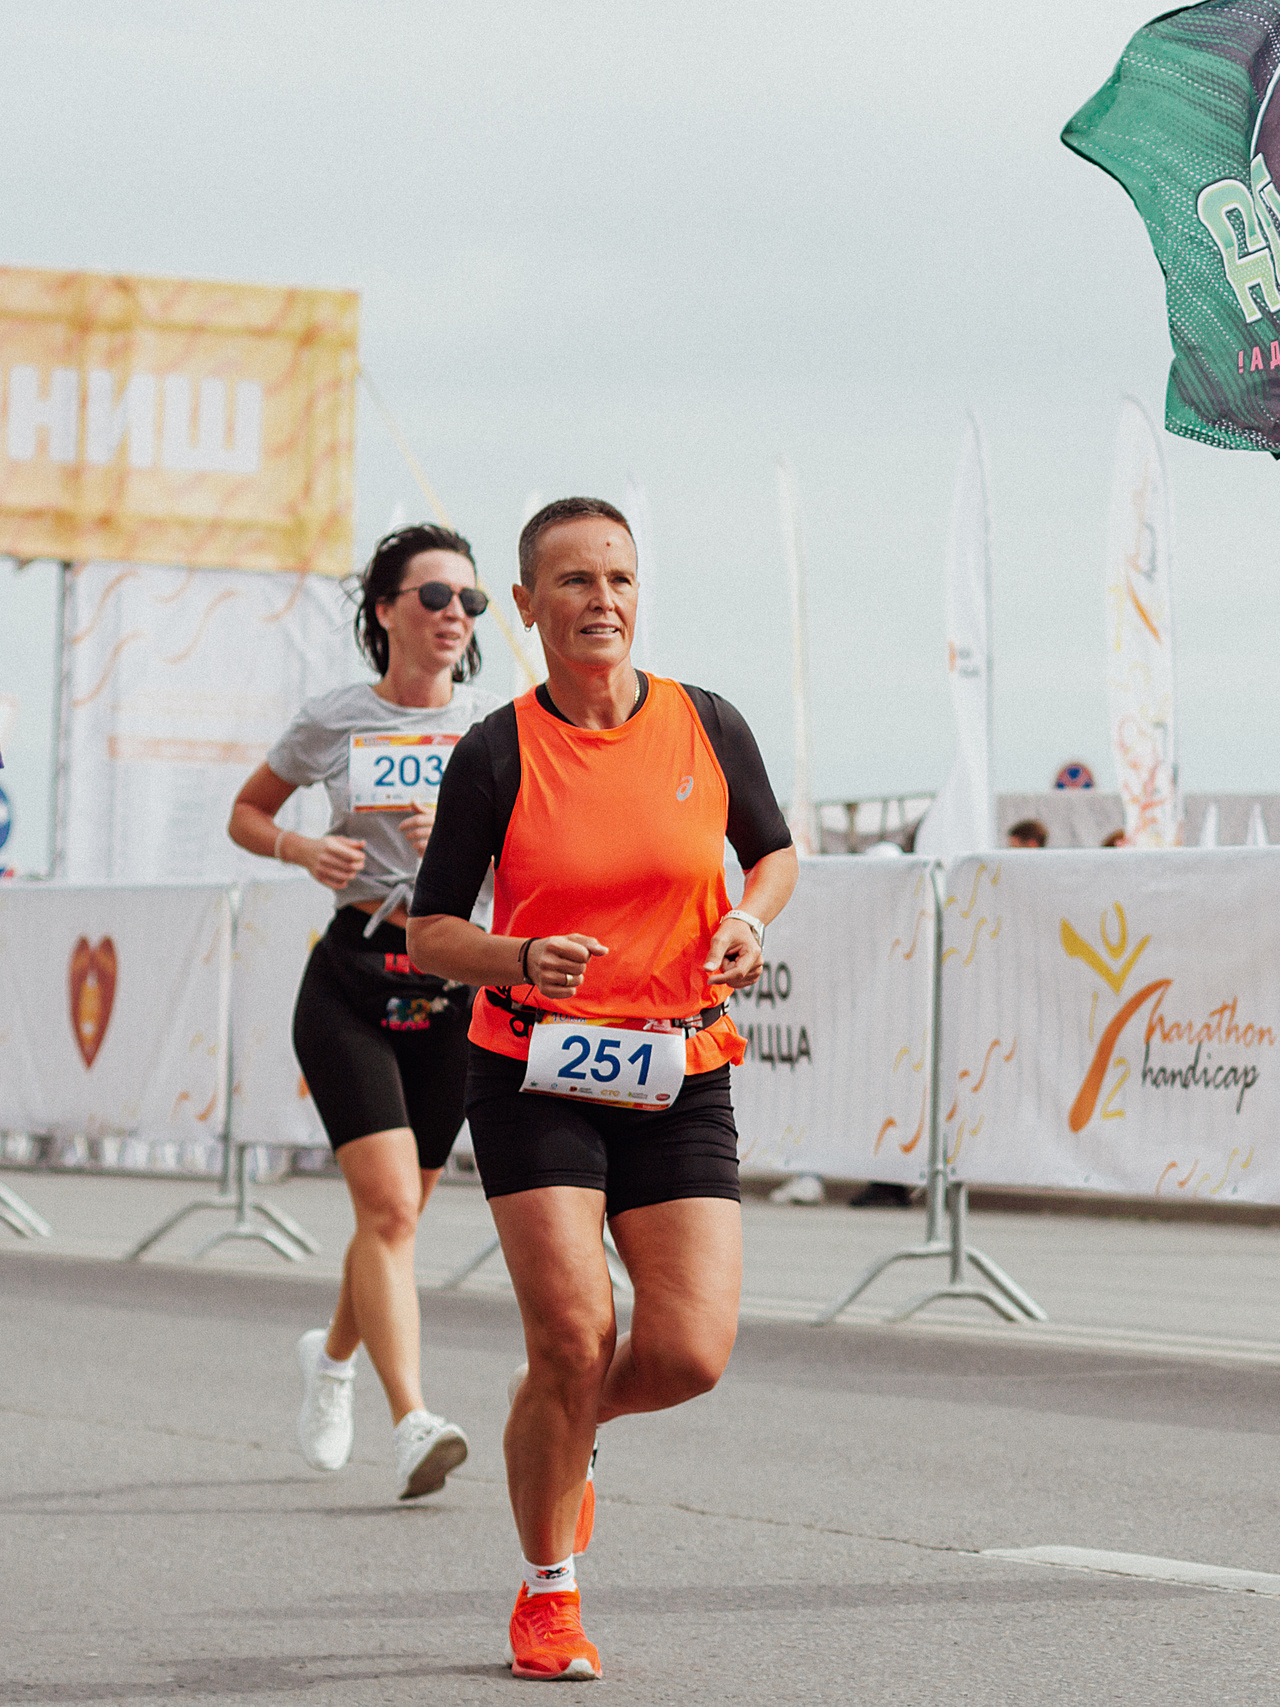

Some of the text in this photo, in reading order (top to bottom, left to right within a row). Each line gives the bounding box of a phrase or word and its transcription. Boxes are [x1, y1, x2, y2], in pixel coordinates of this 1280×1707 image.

[6, 363, 263, 475] НИШ
[374, 754, 443, 787] 203
[731, 961, 792, 1009] ДО
[557, 1034, 653, 1086] 251
[738, 1024, 813, 1071] ИЦЦА
[1141, 1040, 1261, 1115] handicap
